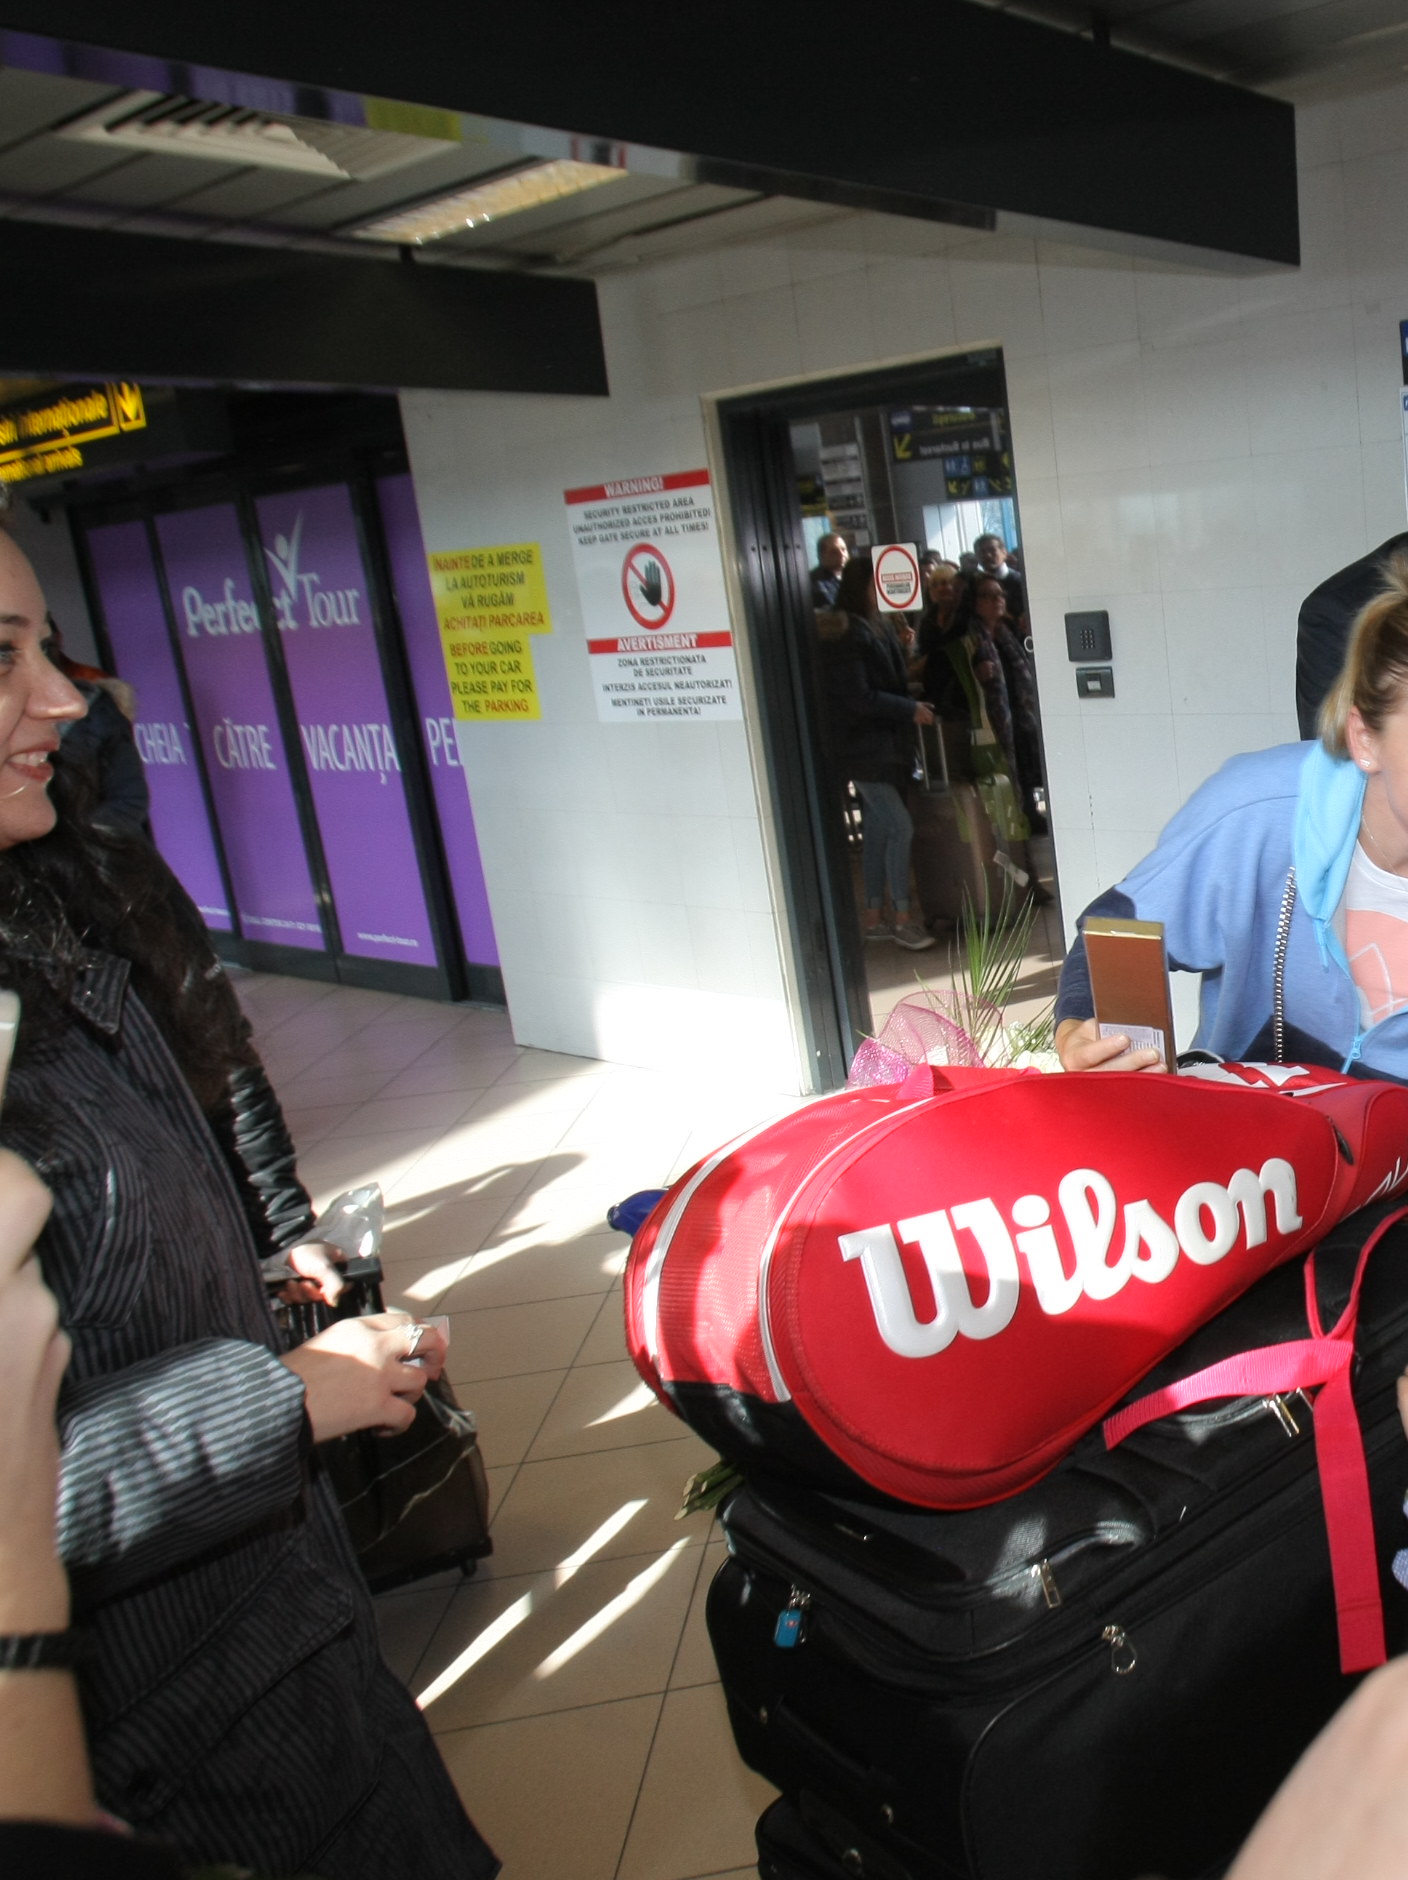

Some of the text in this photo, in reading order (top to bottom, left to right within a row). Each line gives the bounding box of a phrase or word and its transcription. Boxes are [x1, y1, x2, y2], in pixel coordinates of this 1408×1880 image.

[604, 477, 663, 497] WARNING!
[584, 497, 694, 519] SECURITY RESTRICTED AREA
[572, 508, 710, 534] UNAUTHORIZED ACCES PROHIBITED!
[578, 521, 708, 545] KEEP GATE SECURE AT ALL TIMES!
[471, 554, 484, 568] DE
[487, 553, 494, 566] A
[496, 549, 533, 566] MERGE
[446, 571, 525, 591] LA AUTOTURISM
[297, 573, 360, 628] Tour
[489, 612, 544, 627] PARCAREA
[449, 640, 522, 658] BEFORE GOING
[617, 634, 698, 651] AVERTISMENT
[455, 660, 521, 675] TO YOUR CAR
[617, 654, 706, 667] ZONA RESTRICTIONATA
[633, 666, 692, 677] DE SECURITATE
[450, 680, 533, 695] PLEASE PAY FOR
[603, 683, 635, 692] INTERZIS
[638, 682, 672, 691] ACCESUL
[462, 699, 529, 713] THE PARKING
[611, 695, 727, 707] MENTINETI USILE SECURIZATE
[637, 708, 645, 716] IN
[214, 718, 277, 770] CĂTRE
[838, 1156, 1303, 1360] Wilson
